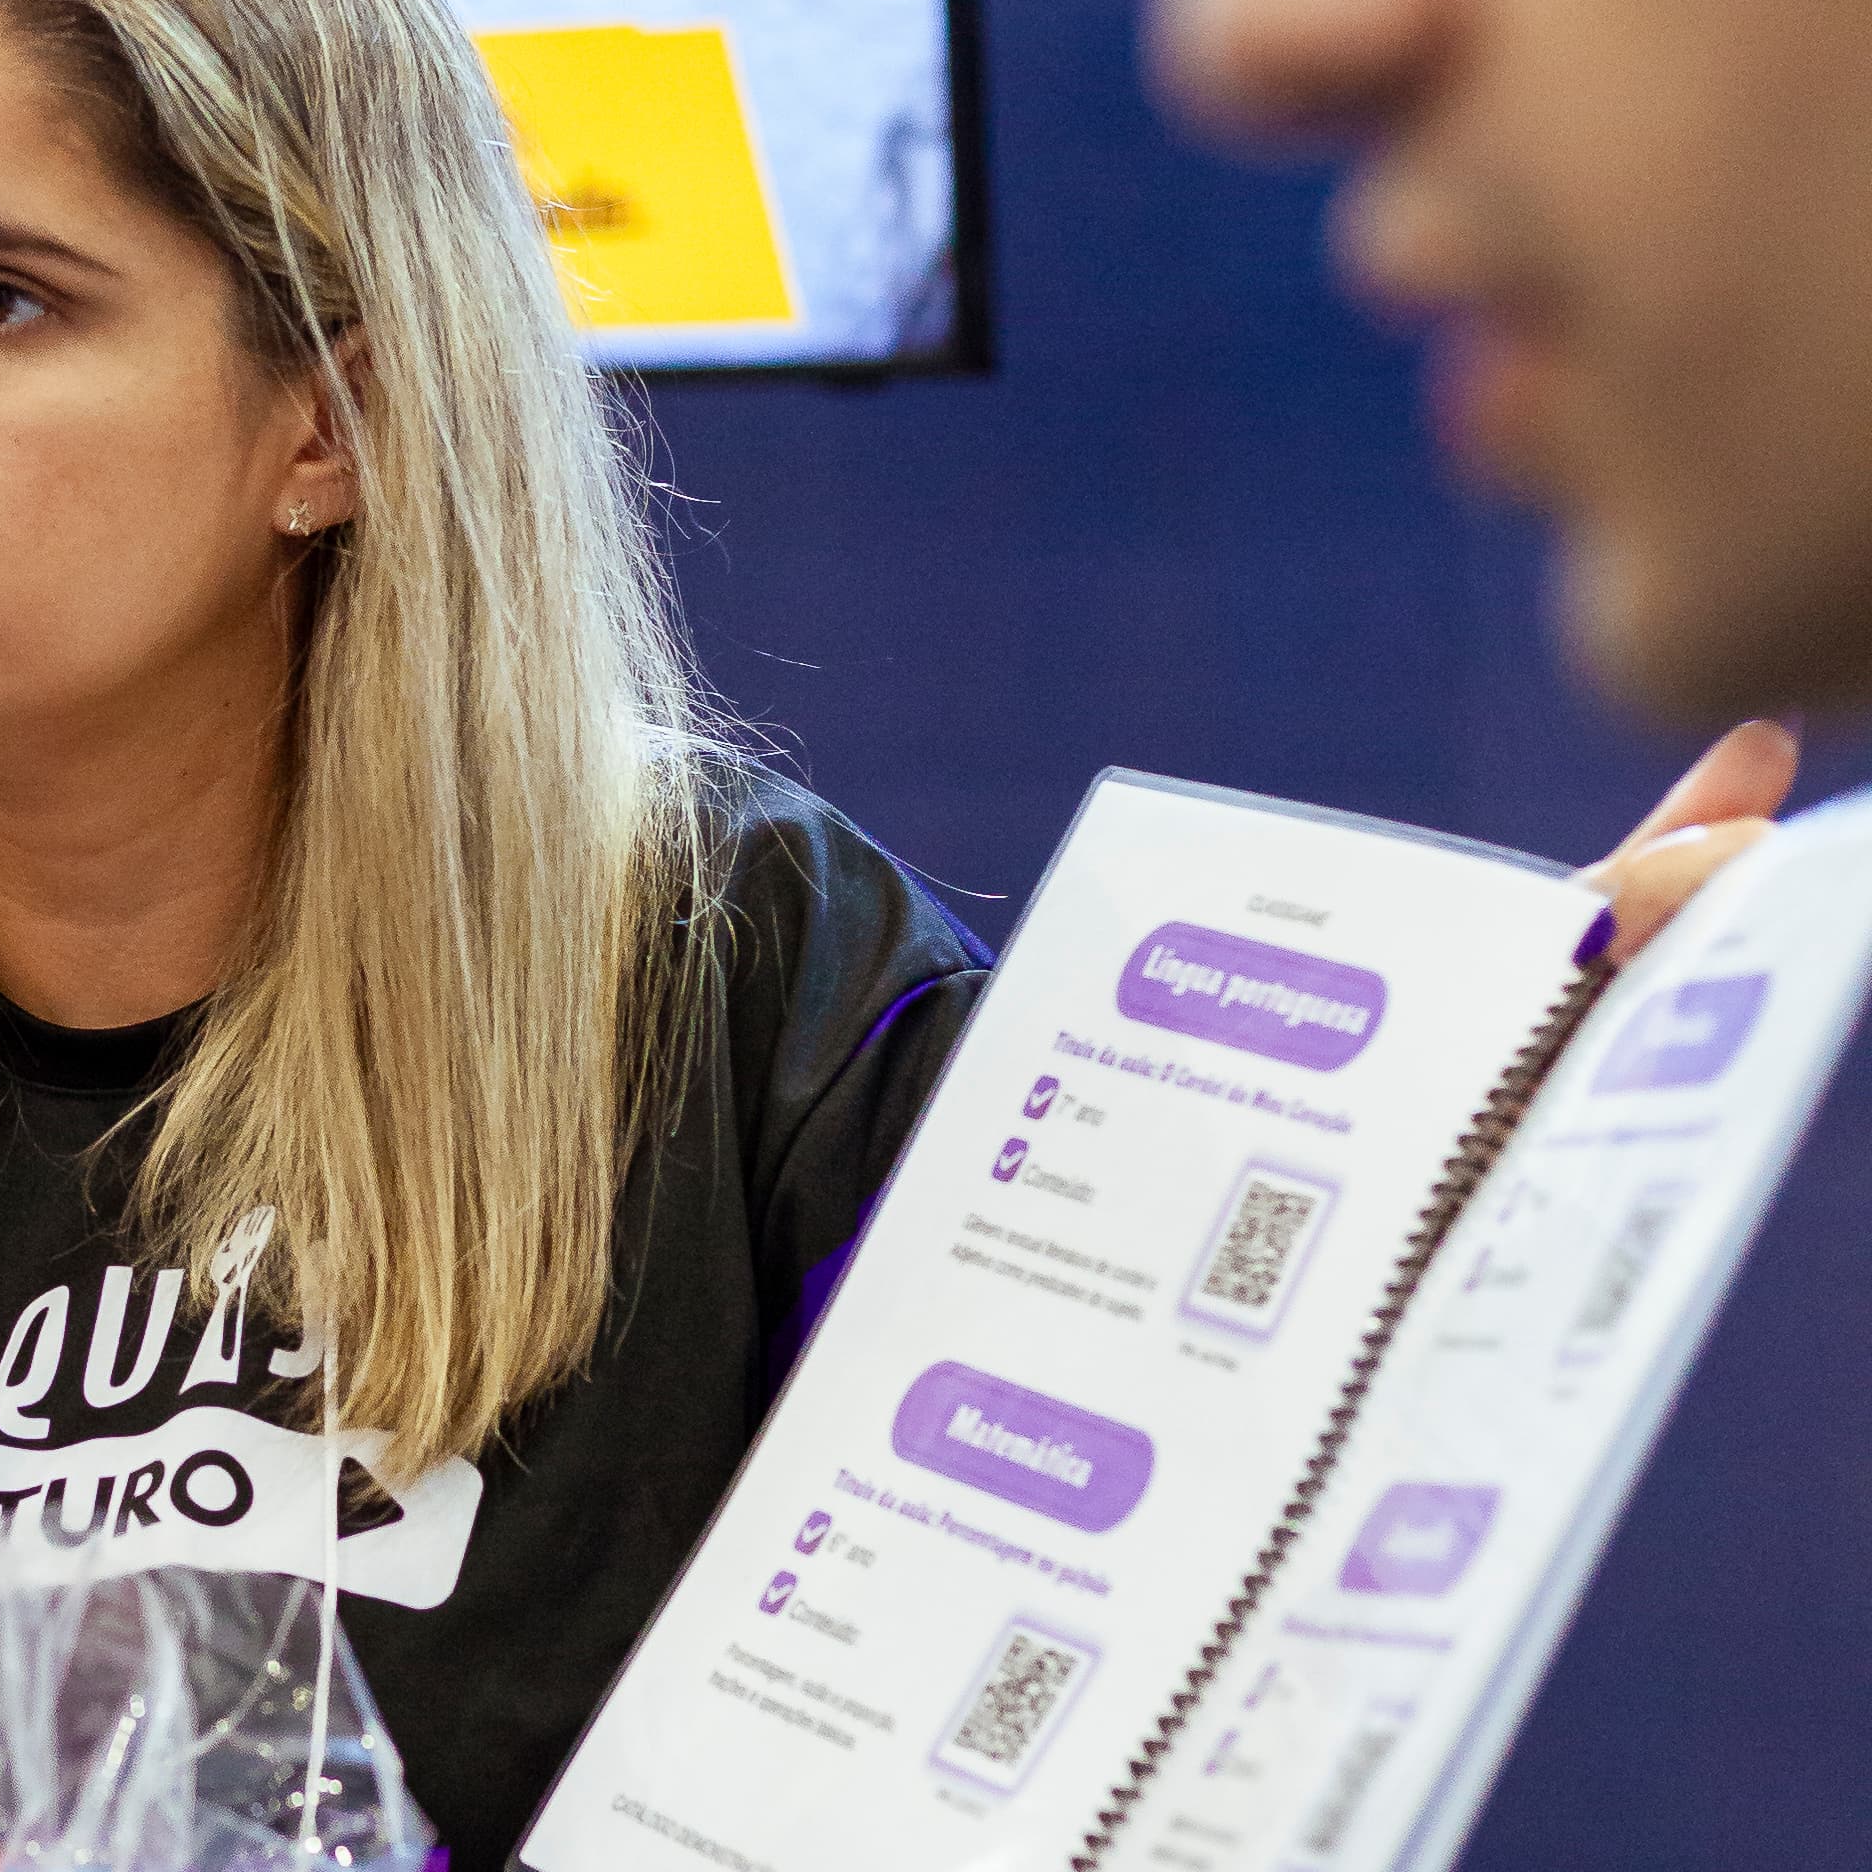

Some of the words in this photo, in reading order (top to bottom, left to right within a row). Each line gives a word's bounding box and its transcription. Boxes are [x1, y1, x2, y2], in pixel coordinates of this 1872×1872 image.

[1142, 943, 1224, 997] Língua
[1217, 974, 1371, 1036] portuguesa
[946, 1403, 1095, 1489] Matemática
